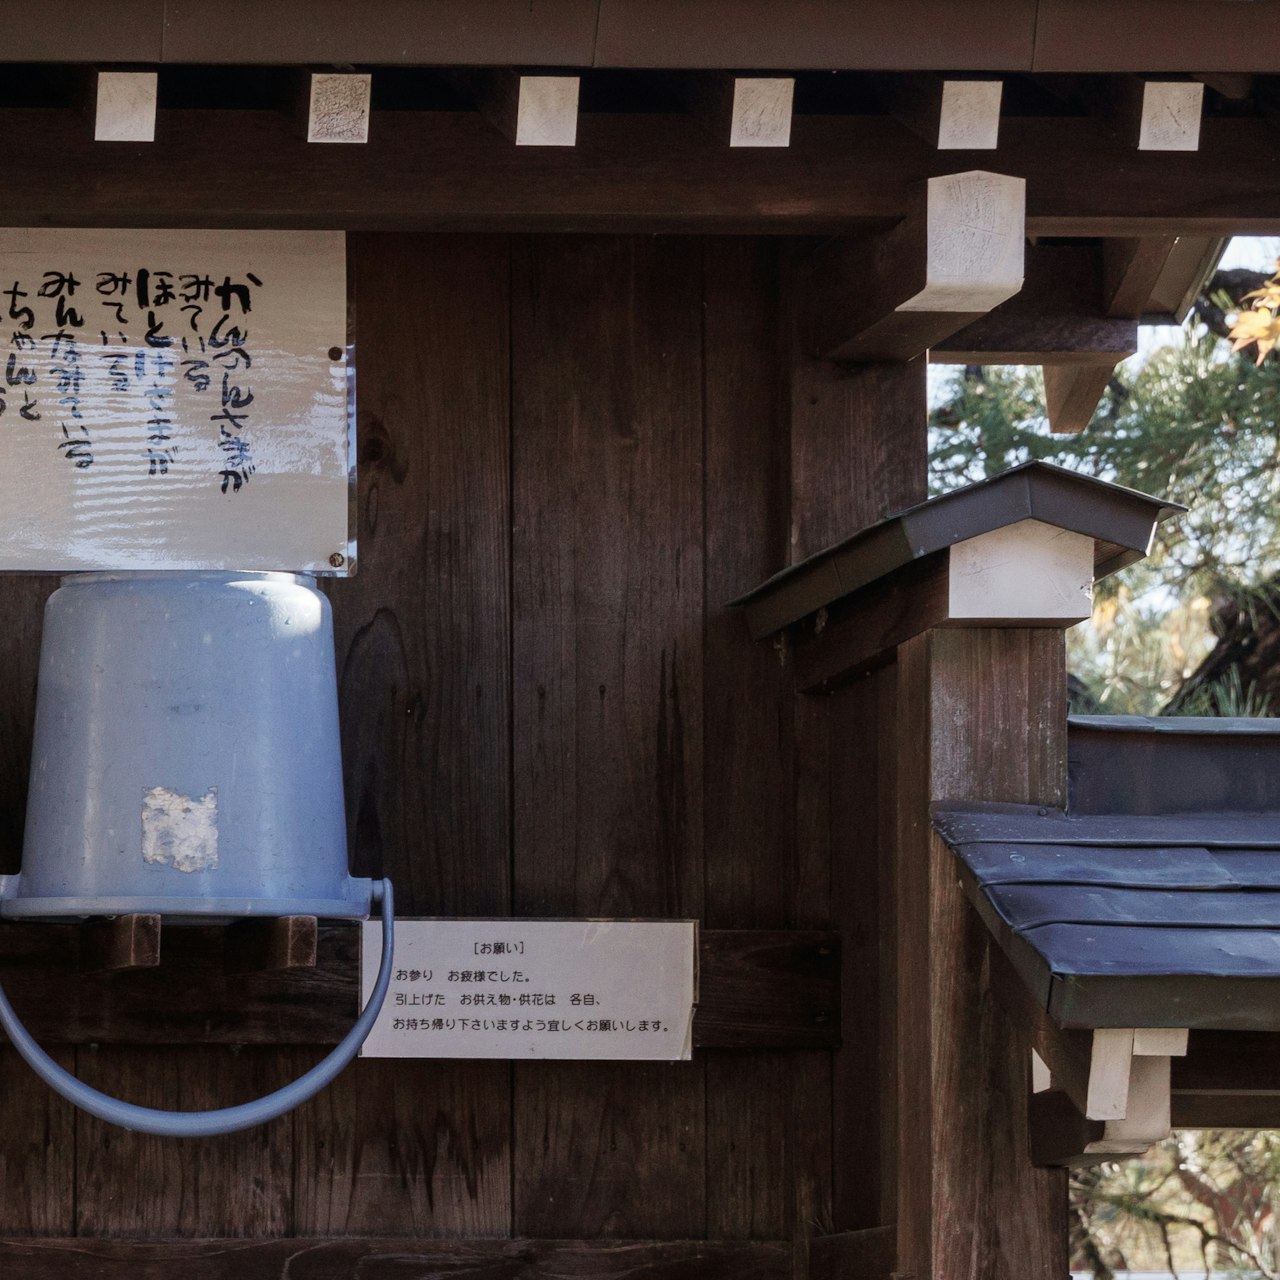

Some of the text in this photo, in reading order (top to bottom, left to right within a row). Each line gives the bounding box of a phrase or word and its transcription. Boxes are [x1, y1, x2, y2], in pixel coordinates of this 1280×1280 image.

[3, 281, 41, 421] ちゃんと
[37, 271, 94, 469] みんなみている
[96, 271, 132, 392] みている
[134, 268, 179, 475] ほとけさまが
[178, 274, 215, 392] みている
[393, 1018, 669, 1032] お持ち帰り下さいますよう宜しくお願いします。
[395, 993, 600, 1006] 引上げた お供え物・供花は 各自、
[396, 969, 530, 983] お参り お疲様でした。
